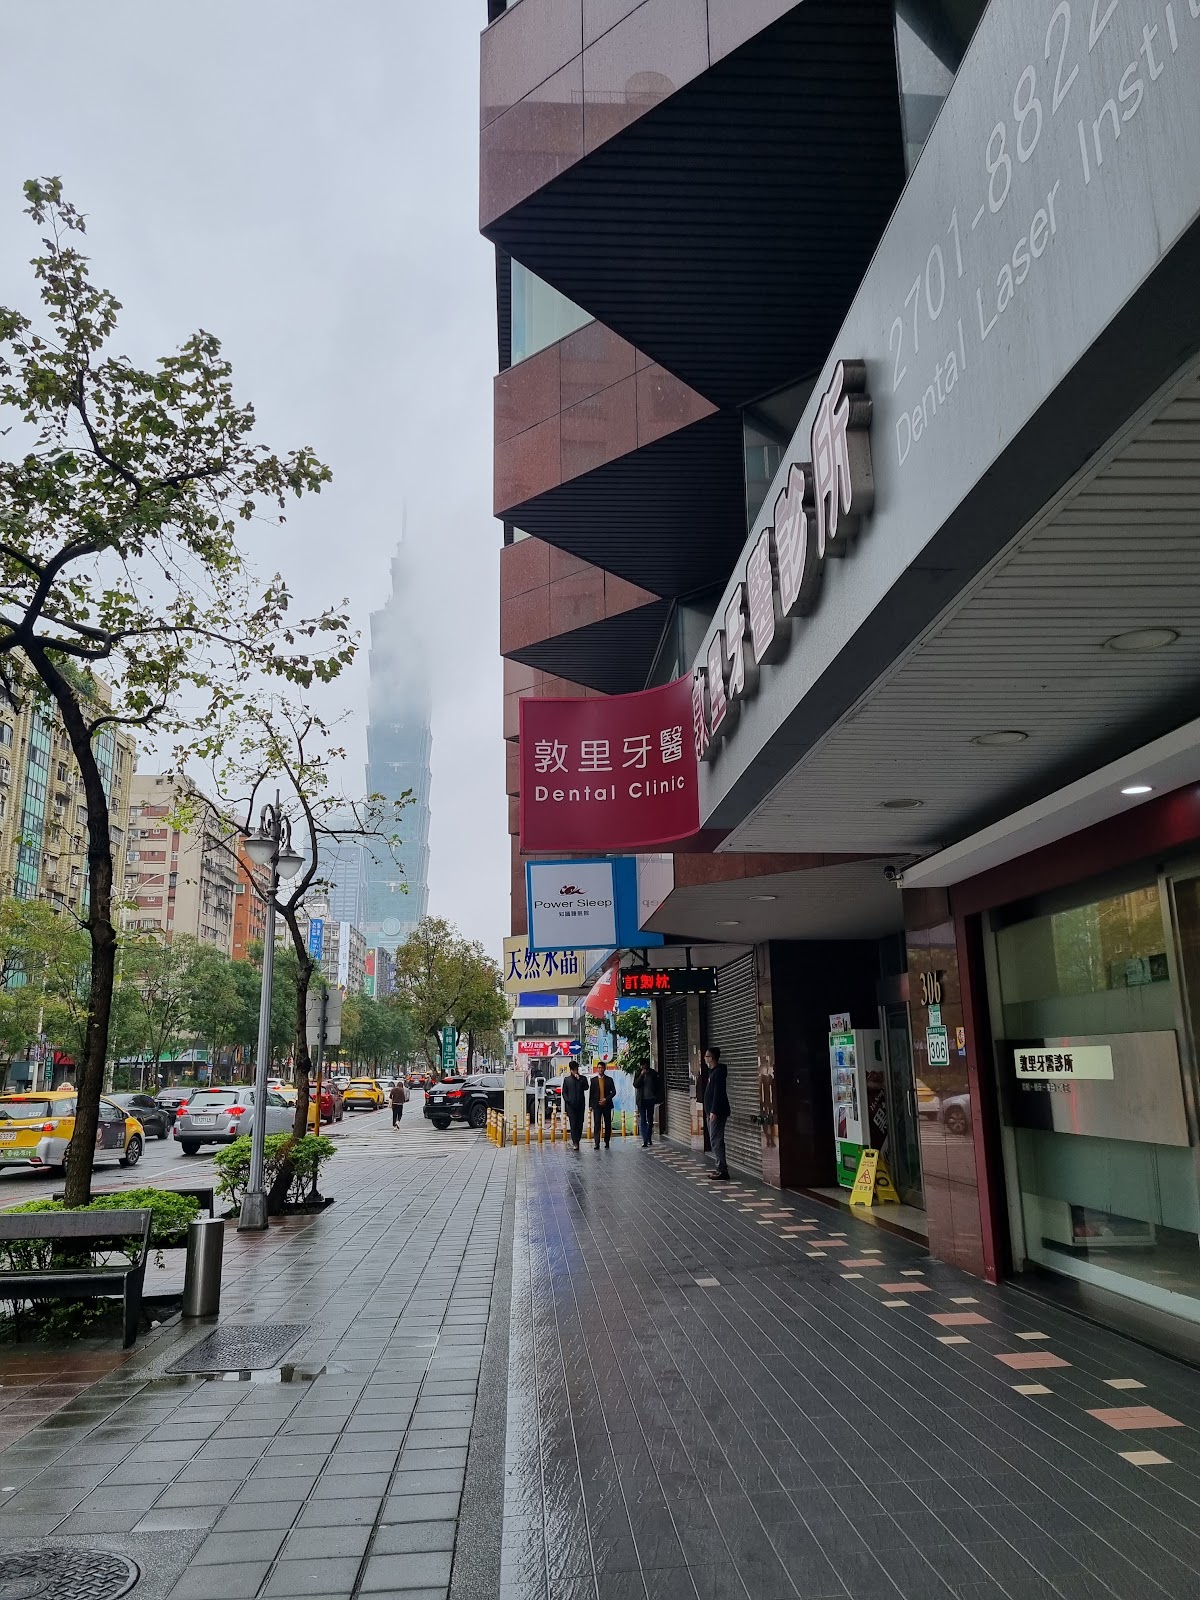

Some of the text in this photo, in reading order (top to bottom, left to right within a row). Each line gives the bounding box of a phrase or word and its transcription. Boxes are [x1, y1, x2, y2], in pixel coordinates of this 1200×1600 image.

[895, 319, 967, 467] Dental
[976, 178, 1060, 342] Laser
[533, 725, 683, 774] 敦里牙醫
[535, 775, 686, 802] Dental Clinic
[534, 898, 612, 909] Power Sleep
[505, 948, 578, 981] 天然水晶
[919, 971, 942, 1006] 306
[930, 1041, 946, 1060] 306
